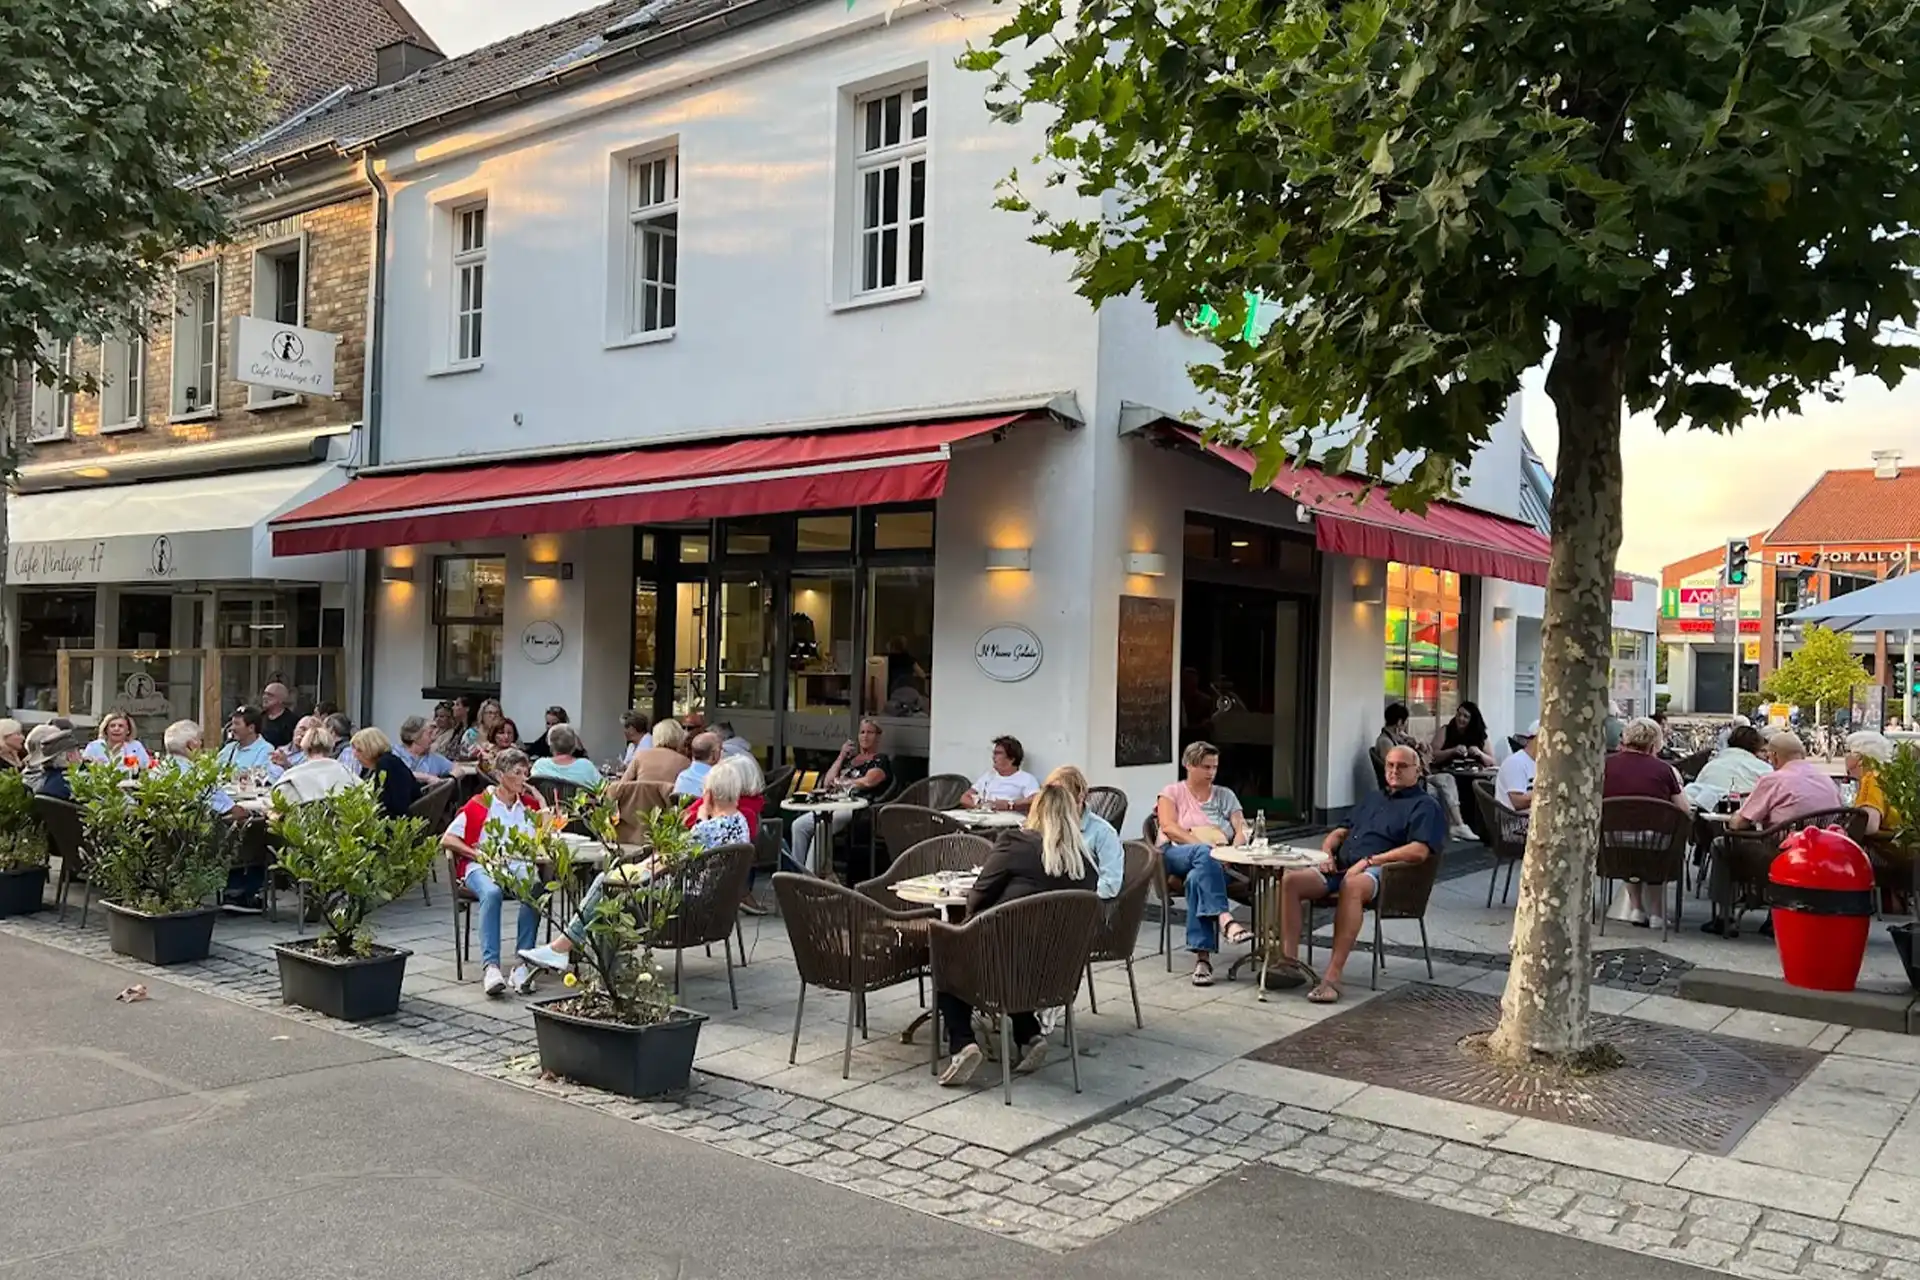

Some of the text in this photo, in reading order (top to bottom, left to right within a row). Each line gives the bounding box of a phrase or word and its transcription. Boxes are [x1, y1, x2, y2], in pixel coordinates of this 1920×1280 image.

[274, 367, 308, 384] Vintage
[14, 545, 38, 581] Cafe
[42, 544, 85, 580] Vintage
[1821, 551, 1852, 562] FOR
[1856, 551, 1885, 562] ALL
